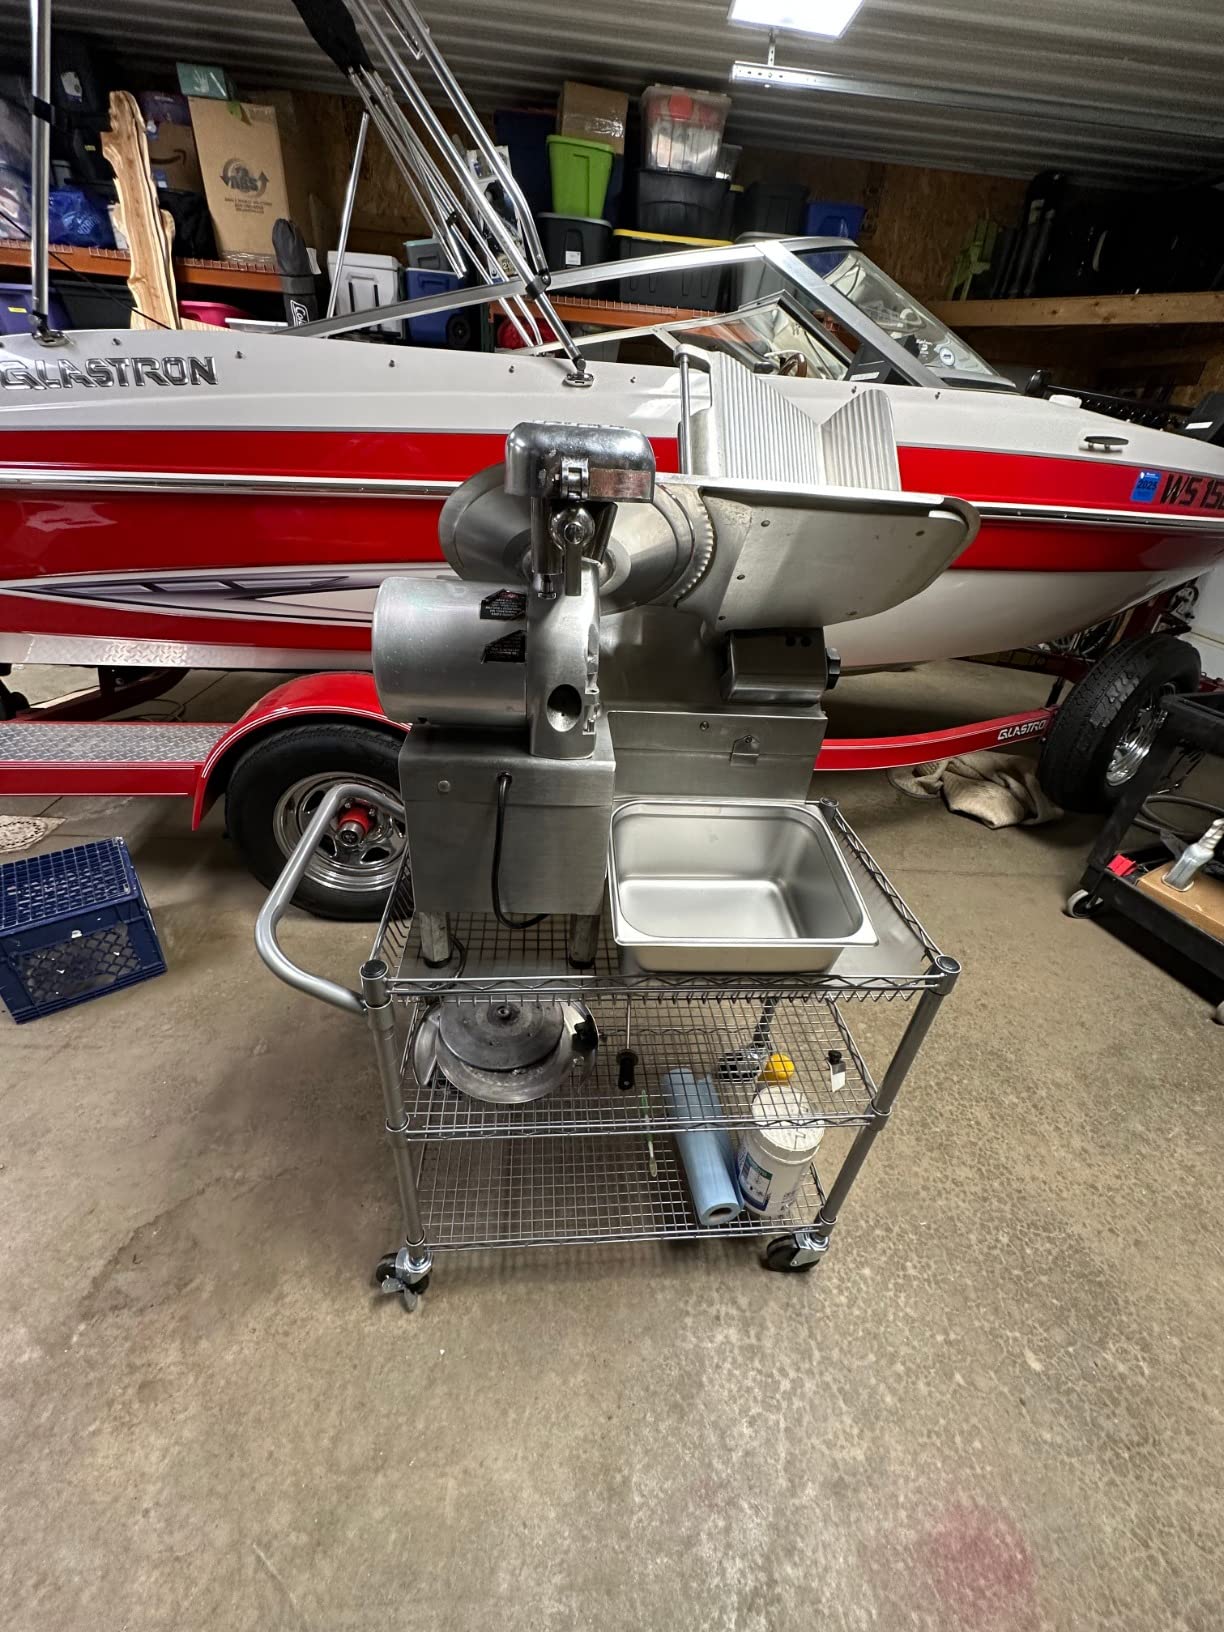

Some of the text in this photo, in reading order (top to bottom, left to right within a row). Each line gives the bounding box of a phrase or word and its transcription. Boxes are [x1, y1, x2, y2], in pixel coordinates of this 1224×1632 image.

[0, 356, 219, 391] GLASTRON
[1161, 473, 1203, 505] WS
[998, 719, 1047, 740] GLASTRO
